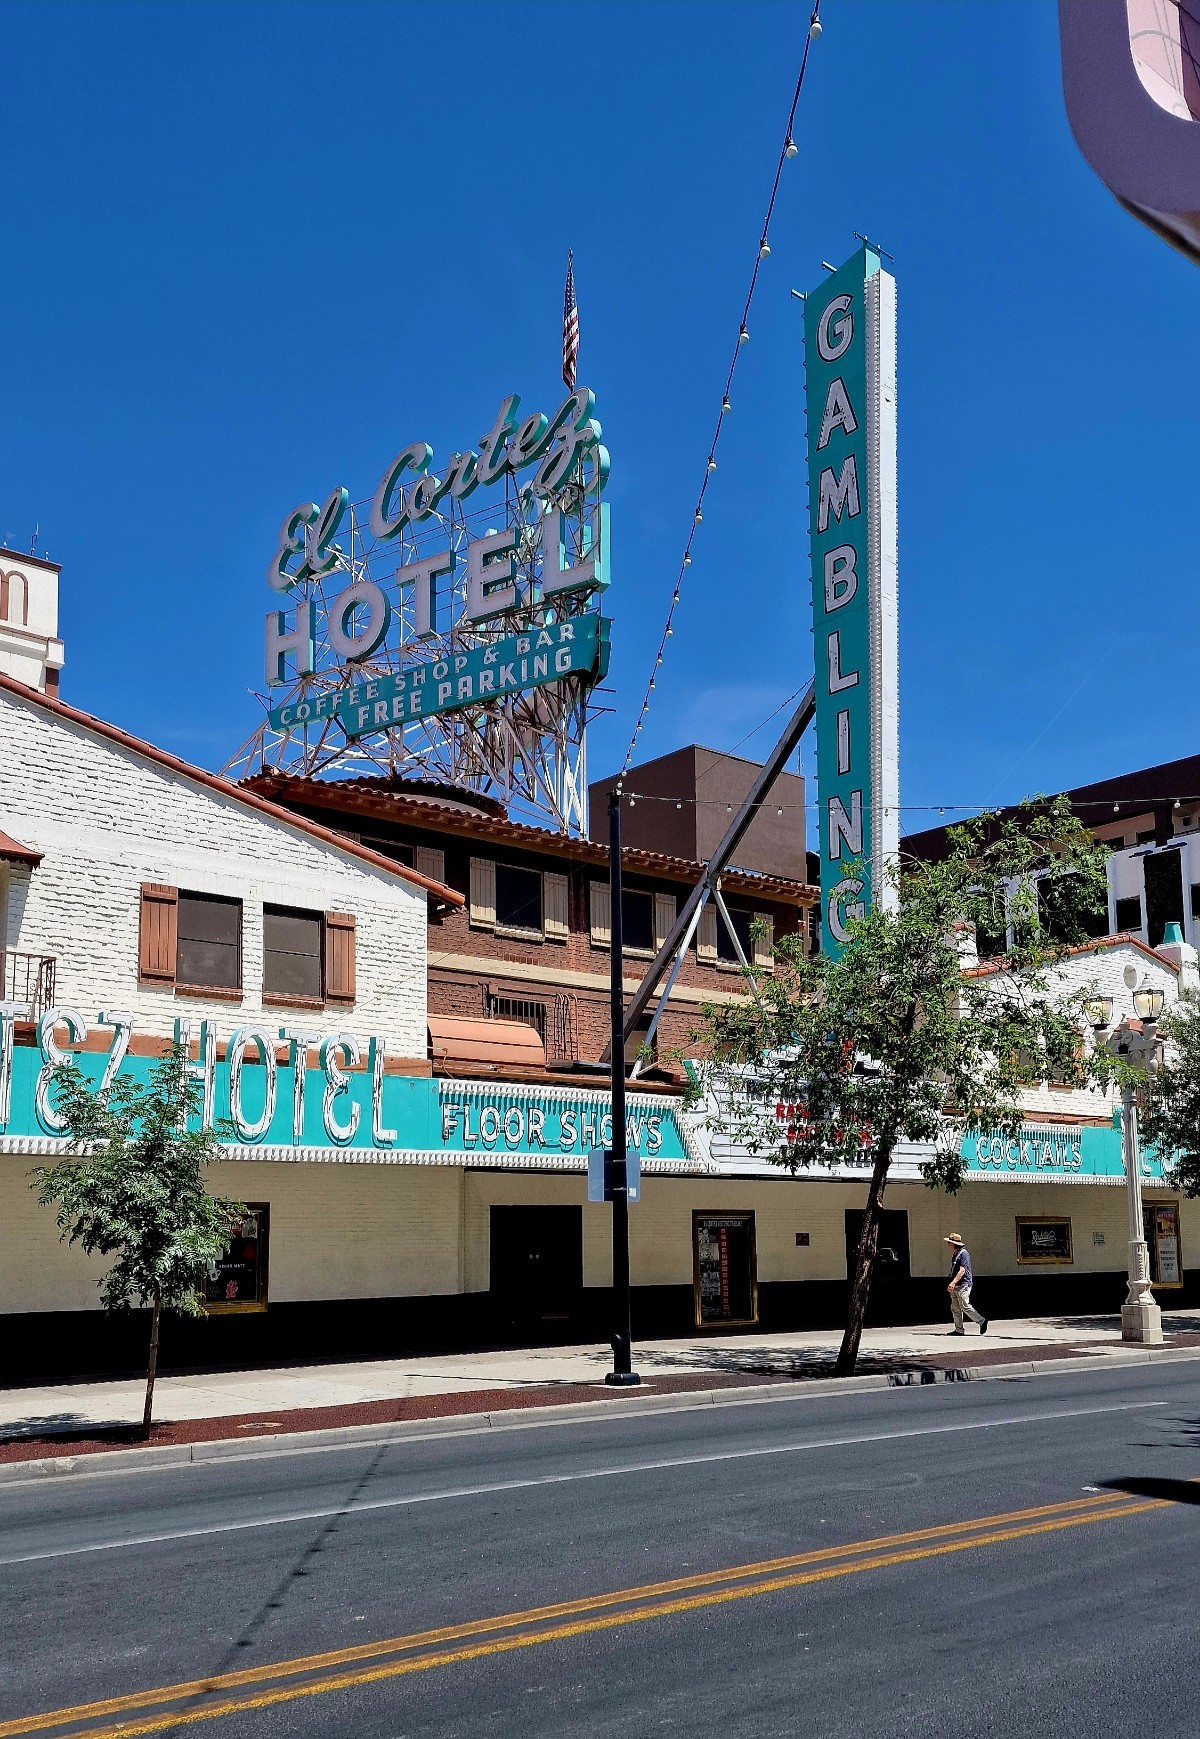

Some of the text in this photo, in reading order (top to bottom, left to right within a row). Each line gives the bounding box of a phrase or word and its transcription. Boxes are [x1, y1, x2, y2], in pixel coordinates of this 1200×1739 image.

[268, 386, 602, 594] El Cortez
[264, 509, 608, 686] HOTEL
[816, 293, 865, 943] GAMBLING
[279, 623, 576, 725] COFFEE SHOP & BAR
[358, 647, 572, 730] FREE PARKING
[174, 1017, 398, 1142] HOTEL
[442, 1101, 664, 1149] FLOOR SHOWS
[976, 1135, 1083, 1168] COCKTAILS
